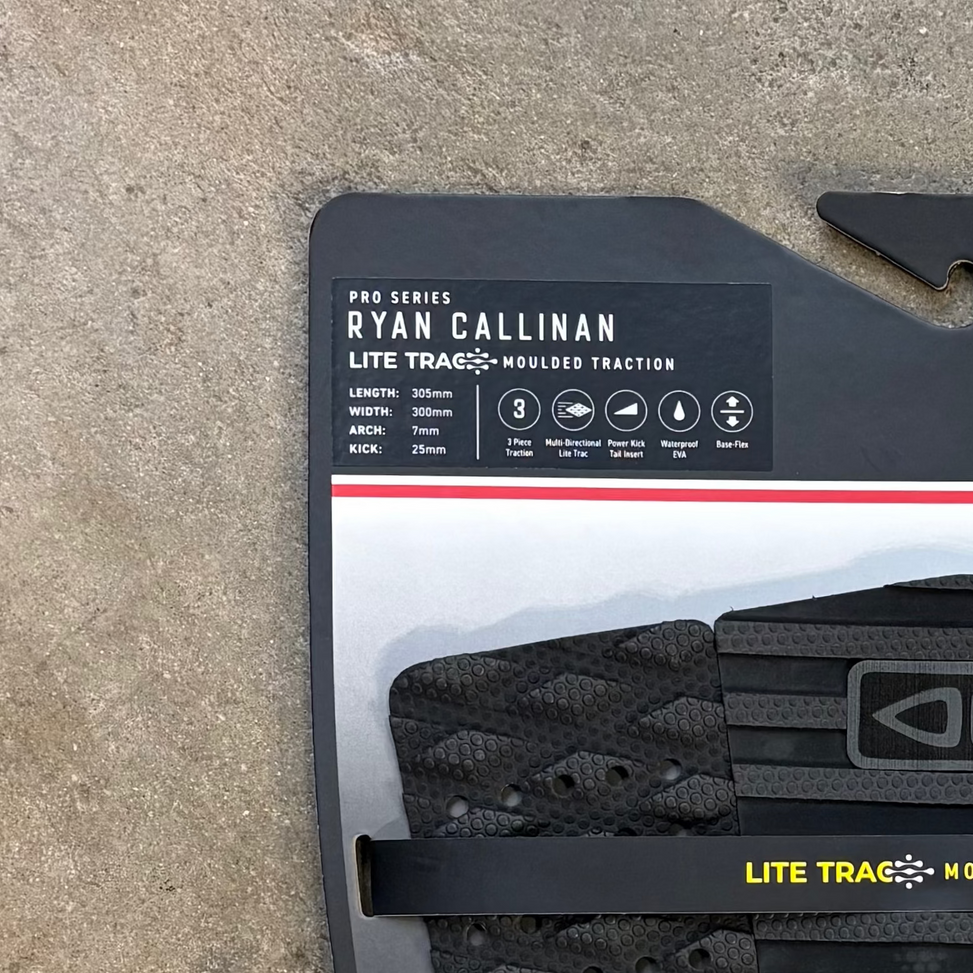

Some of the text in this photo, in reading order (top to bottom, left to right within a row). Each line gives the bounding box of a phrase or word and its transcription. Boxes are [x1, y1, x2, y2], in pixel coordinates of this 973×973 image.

[349, 290, 451, 305] PRO SERIES
[347, 310, 615, 342] RYAN CALLINAN
[349, 352, 675, 371] LITE TRAC MOULDED TRACTION
[349, 387, 453, 399] LENGTH: 305mm
[349, 406, 453, 418] WIDTH: 300mm
[349, 425, 440, 436] ARCH: 7mm
[507, 437, 532, 446] 3 Piece
[545, 438, 602, 447] Multi-Directional
[607, 439, 646, 448] Power Kick
[660, 439, 699, 450] Waterproof
[716, 440, 749, 449] Base-Flex
[349, 443, 447, 455] KICK: 25mm
[505, 448, 534, 457] Traction
[558, 449, 589, 458] Lite Trac
[609, 450, 644, 459] Tail Insert
[672, 450, 687, 459] EVA
[745, 861, 807, 884] LITE
[816, 861, 894, 883] TRAC
